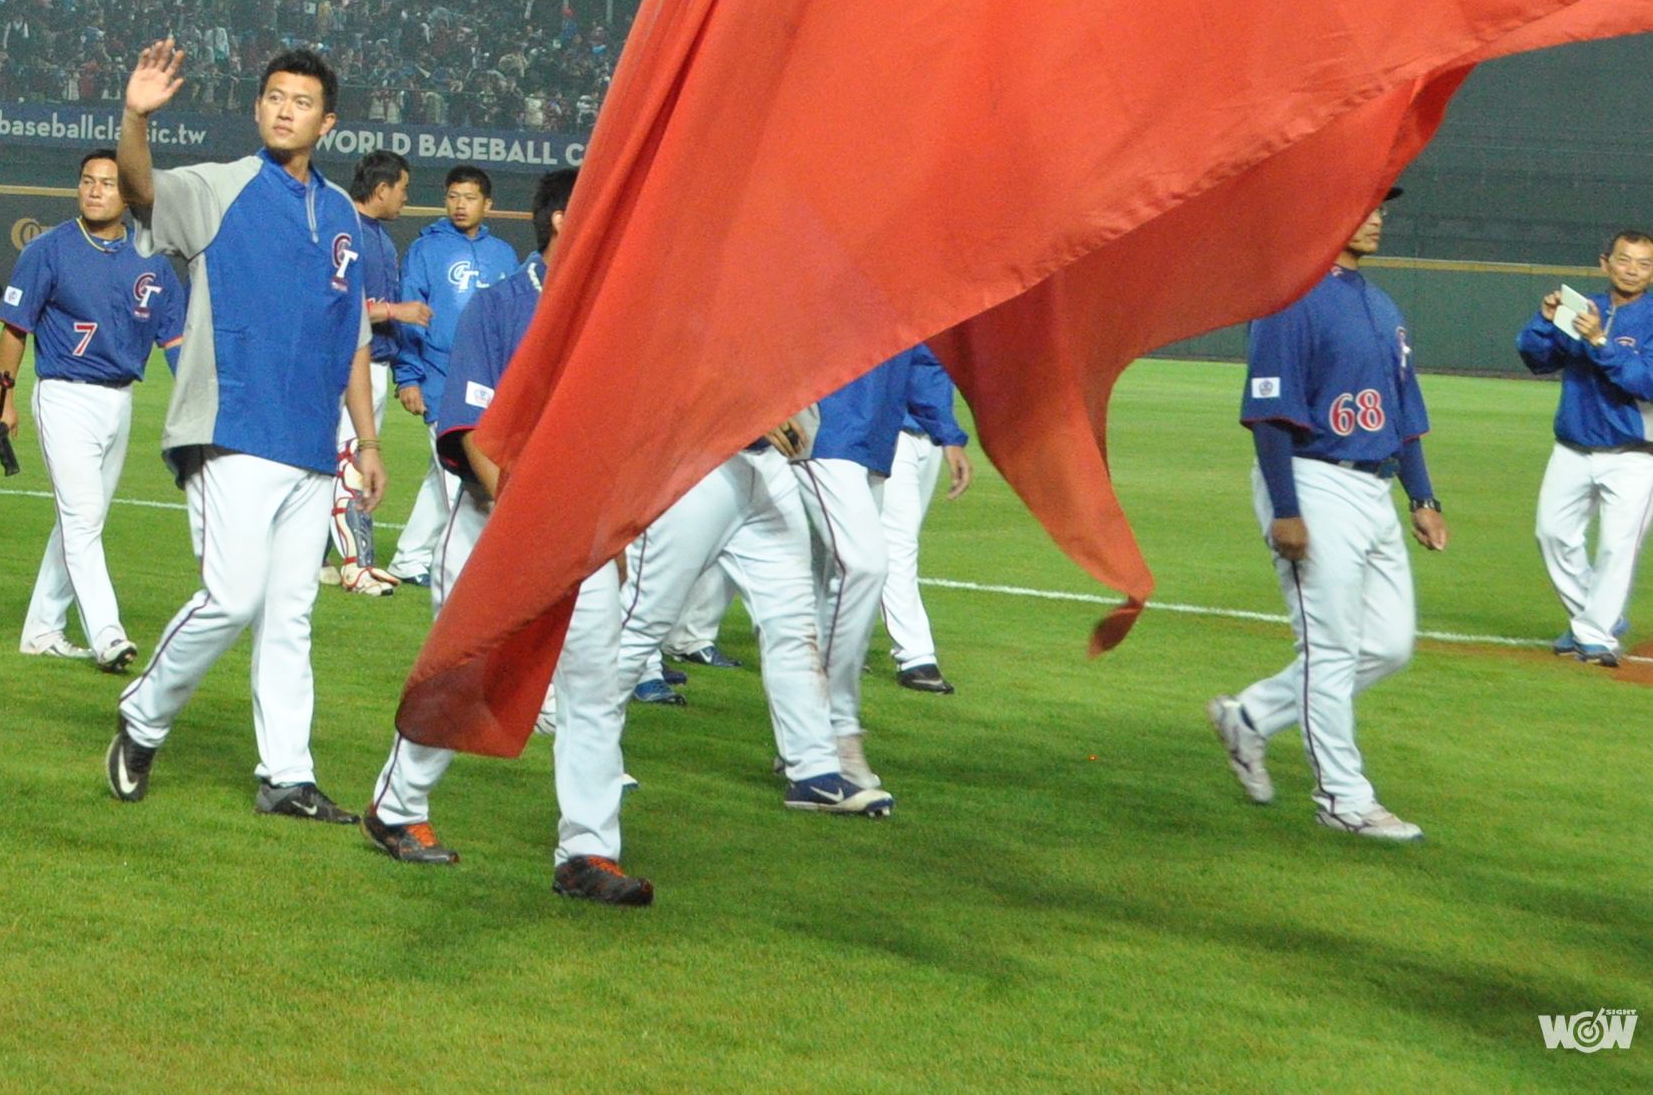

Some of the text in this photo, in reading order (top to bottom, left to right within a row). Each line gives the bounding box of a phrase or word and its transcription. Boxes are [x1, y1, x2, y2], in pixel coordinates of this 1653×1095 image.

[316, 129, 411, 157] WORLD
[418, 133, 558, 165] BASEBALL
[72, 322, 98, 356] 7
[1329, 388, 1385, 436] 68
